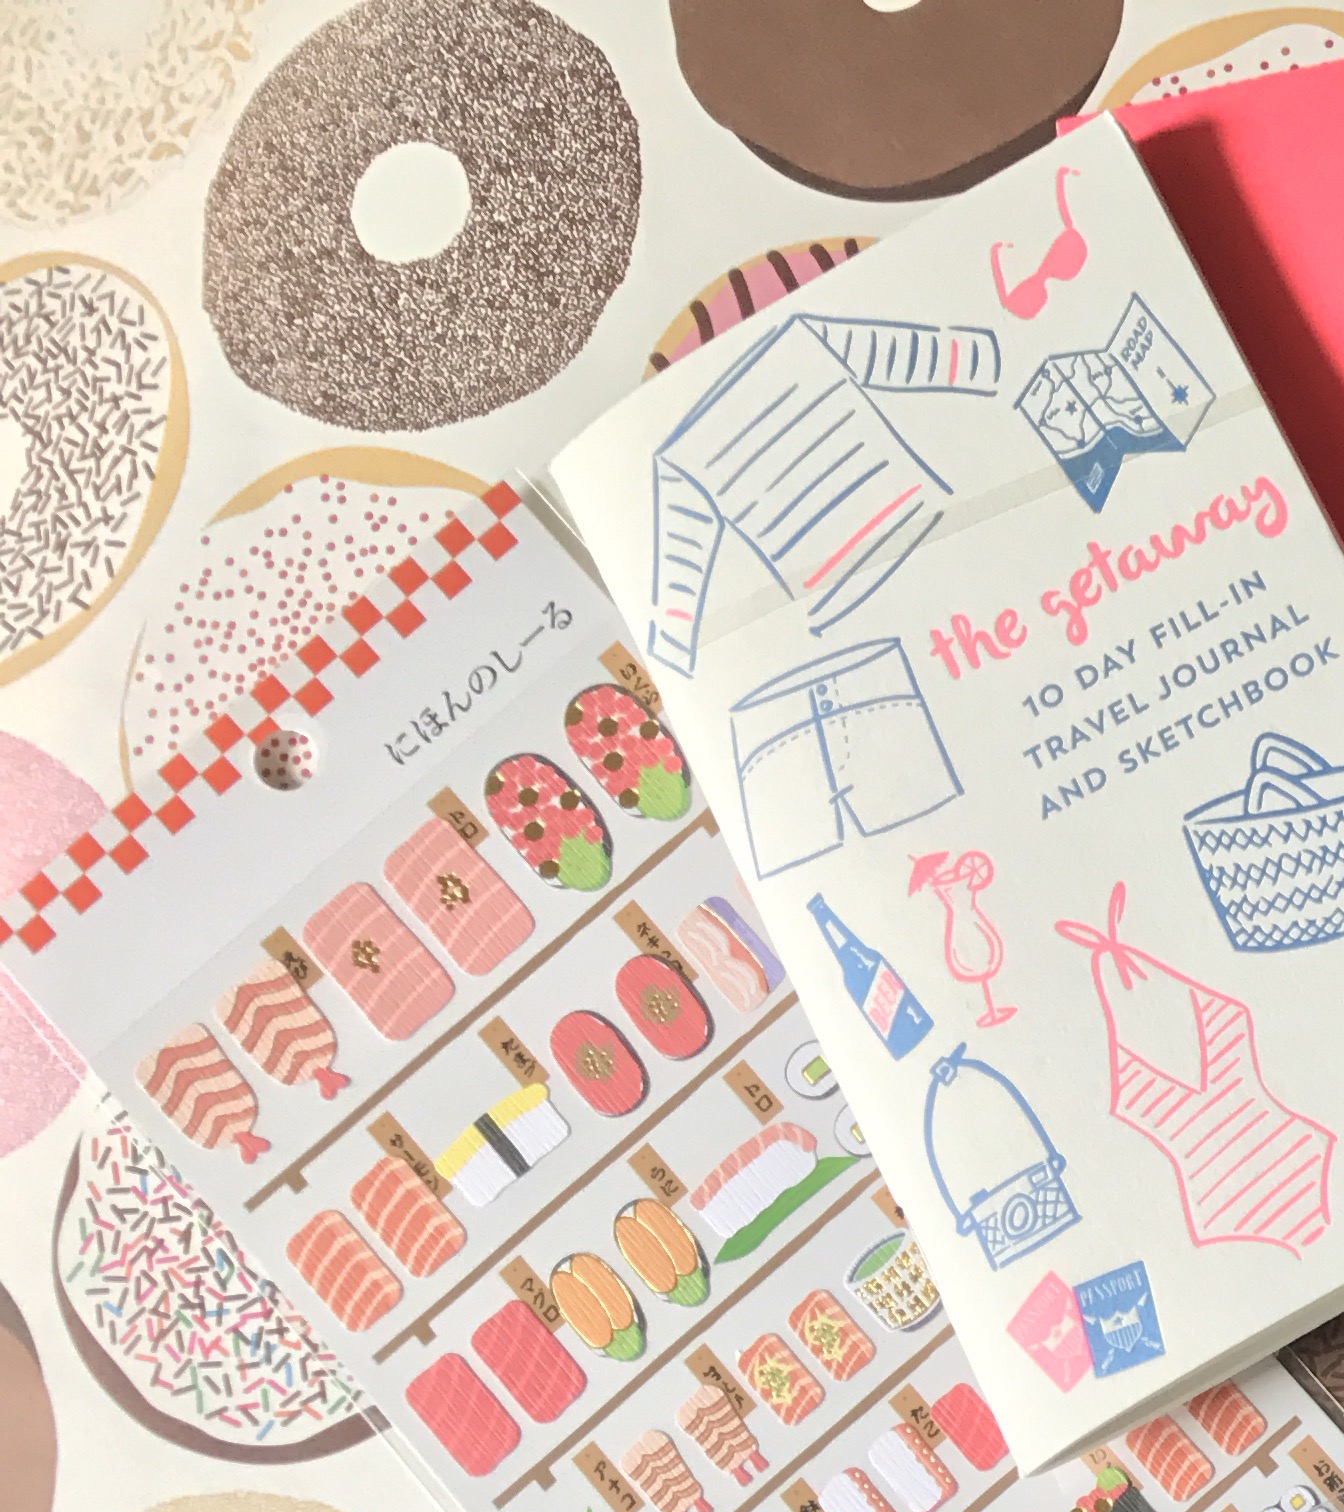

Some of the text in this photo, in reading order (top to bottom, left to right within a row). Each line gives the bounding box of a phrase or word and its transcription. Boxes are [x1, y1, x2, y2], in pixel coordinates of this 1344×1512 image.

[1120, 316, 1147, 364] ROAD
[1130, 330, 1154, 371] MAP
[929, 475, 1290, 680] the getaway
[1021, 570, 1268, 718] 10 DAY FILL-IN
[384, 600, 574, 767] にほんのしーる
[1024, 603, 1310, 772] TRAVEL JOURNAL
[1040, 636, 1340, 821] AND SKETCHBOOK
[744, 1082, 774, 1113] トロ
[650, 1166, 678, 1197] うに
[520, 1277, 560, 1323] マグロ
[1079, 1270, 1143, 1308] PASSPORT
